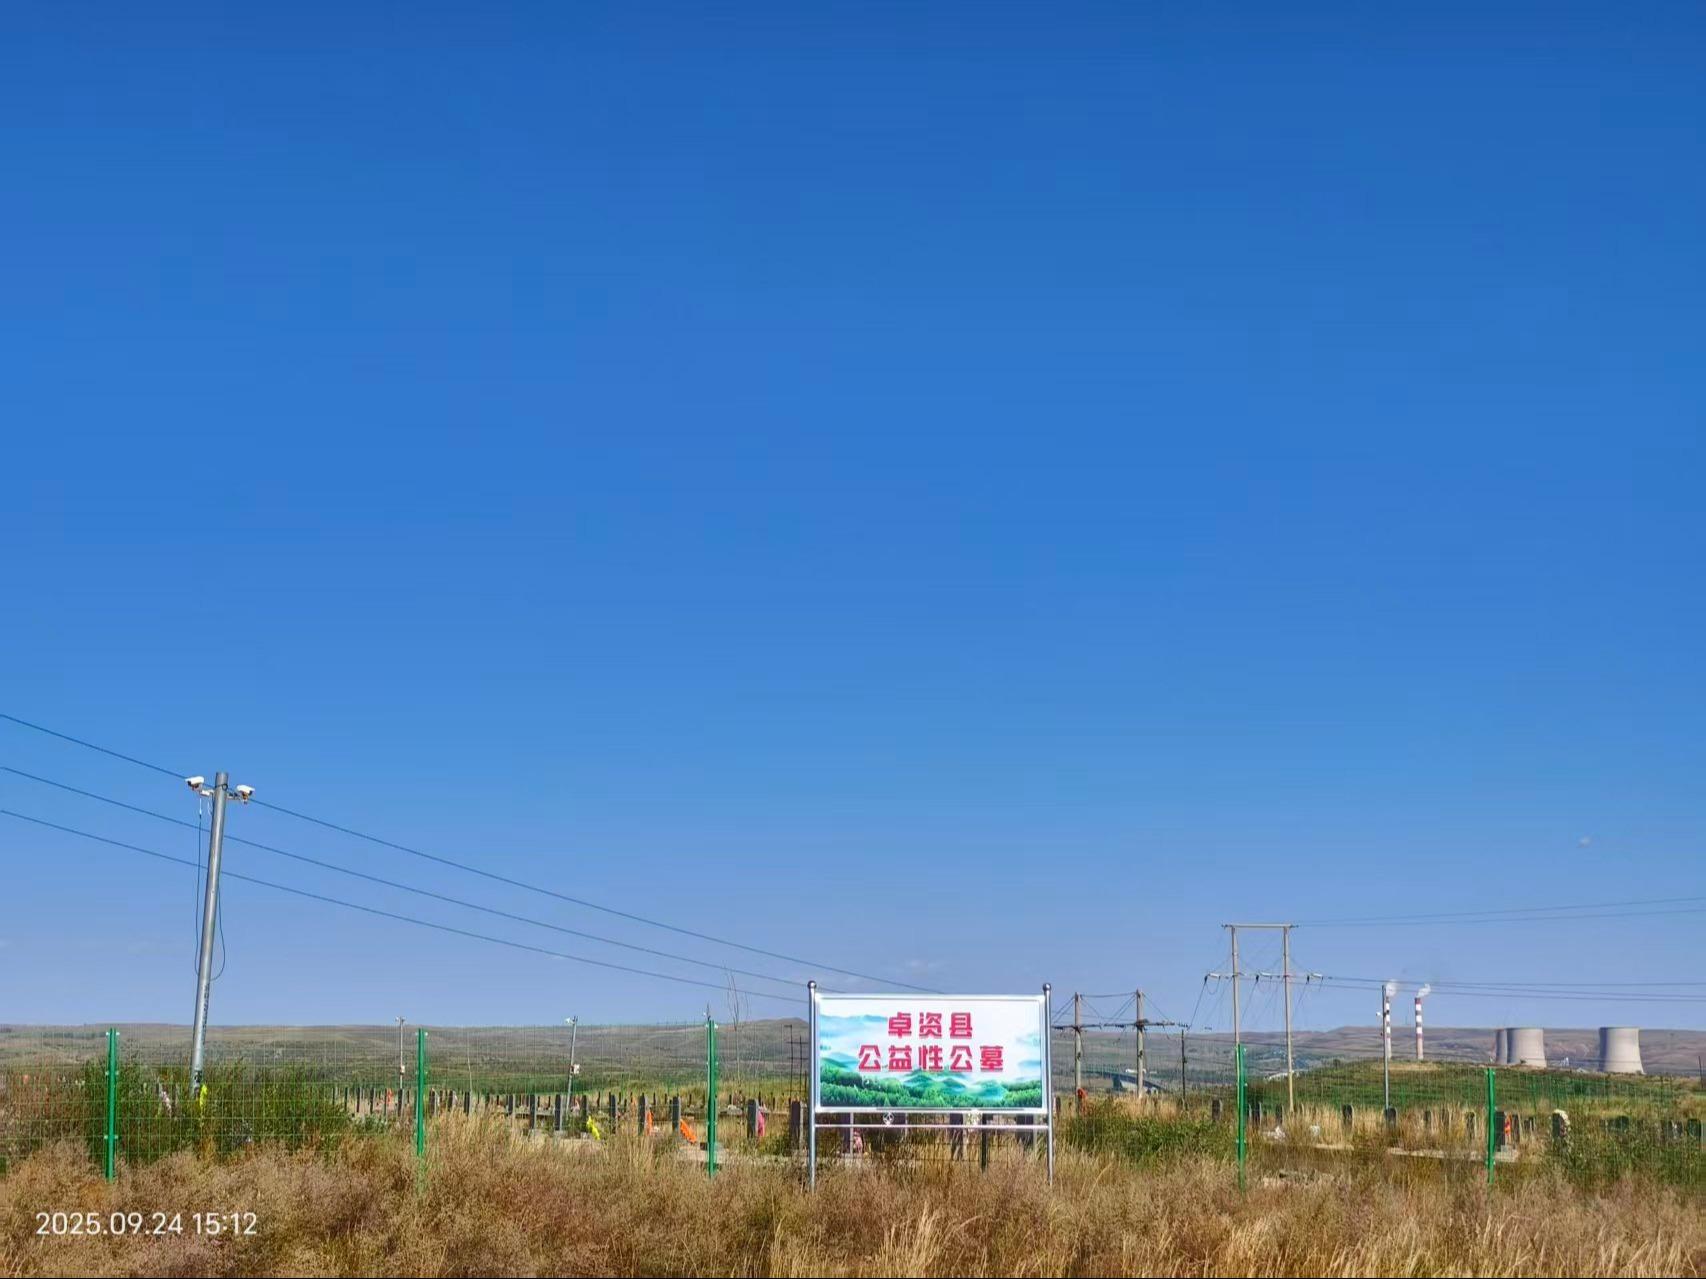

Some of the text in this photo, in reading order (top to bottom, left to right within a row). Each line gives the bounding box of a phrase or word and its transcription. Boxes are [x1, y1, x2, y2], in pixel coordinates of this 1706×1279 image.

[888, 1012, 973, 1039] 卓资县
[858, 1045, 1004, 1072] 公益性公墓
